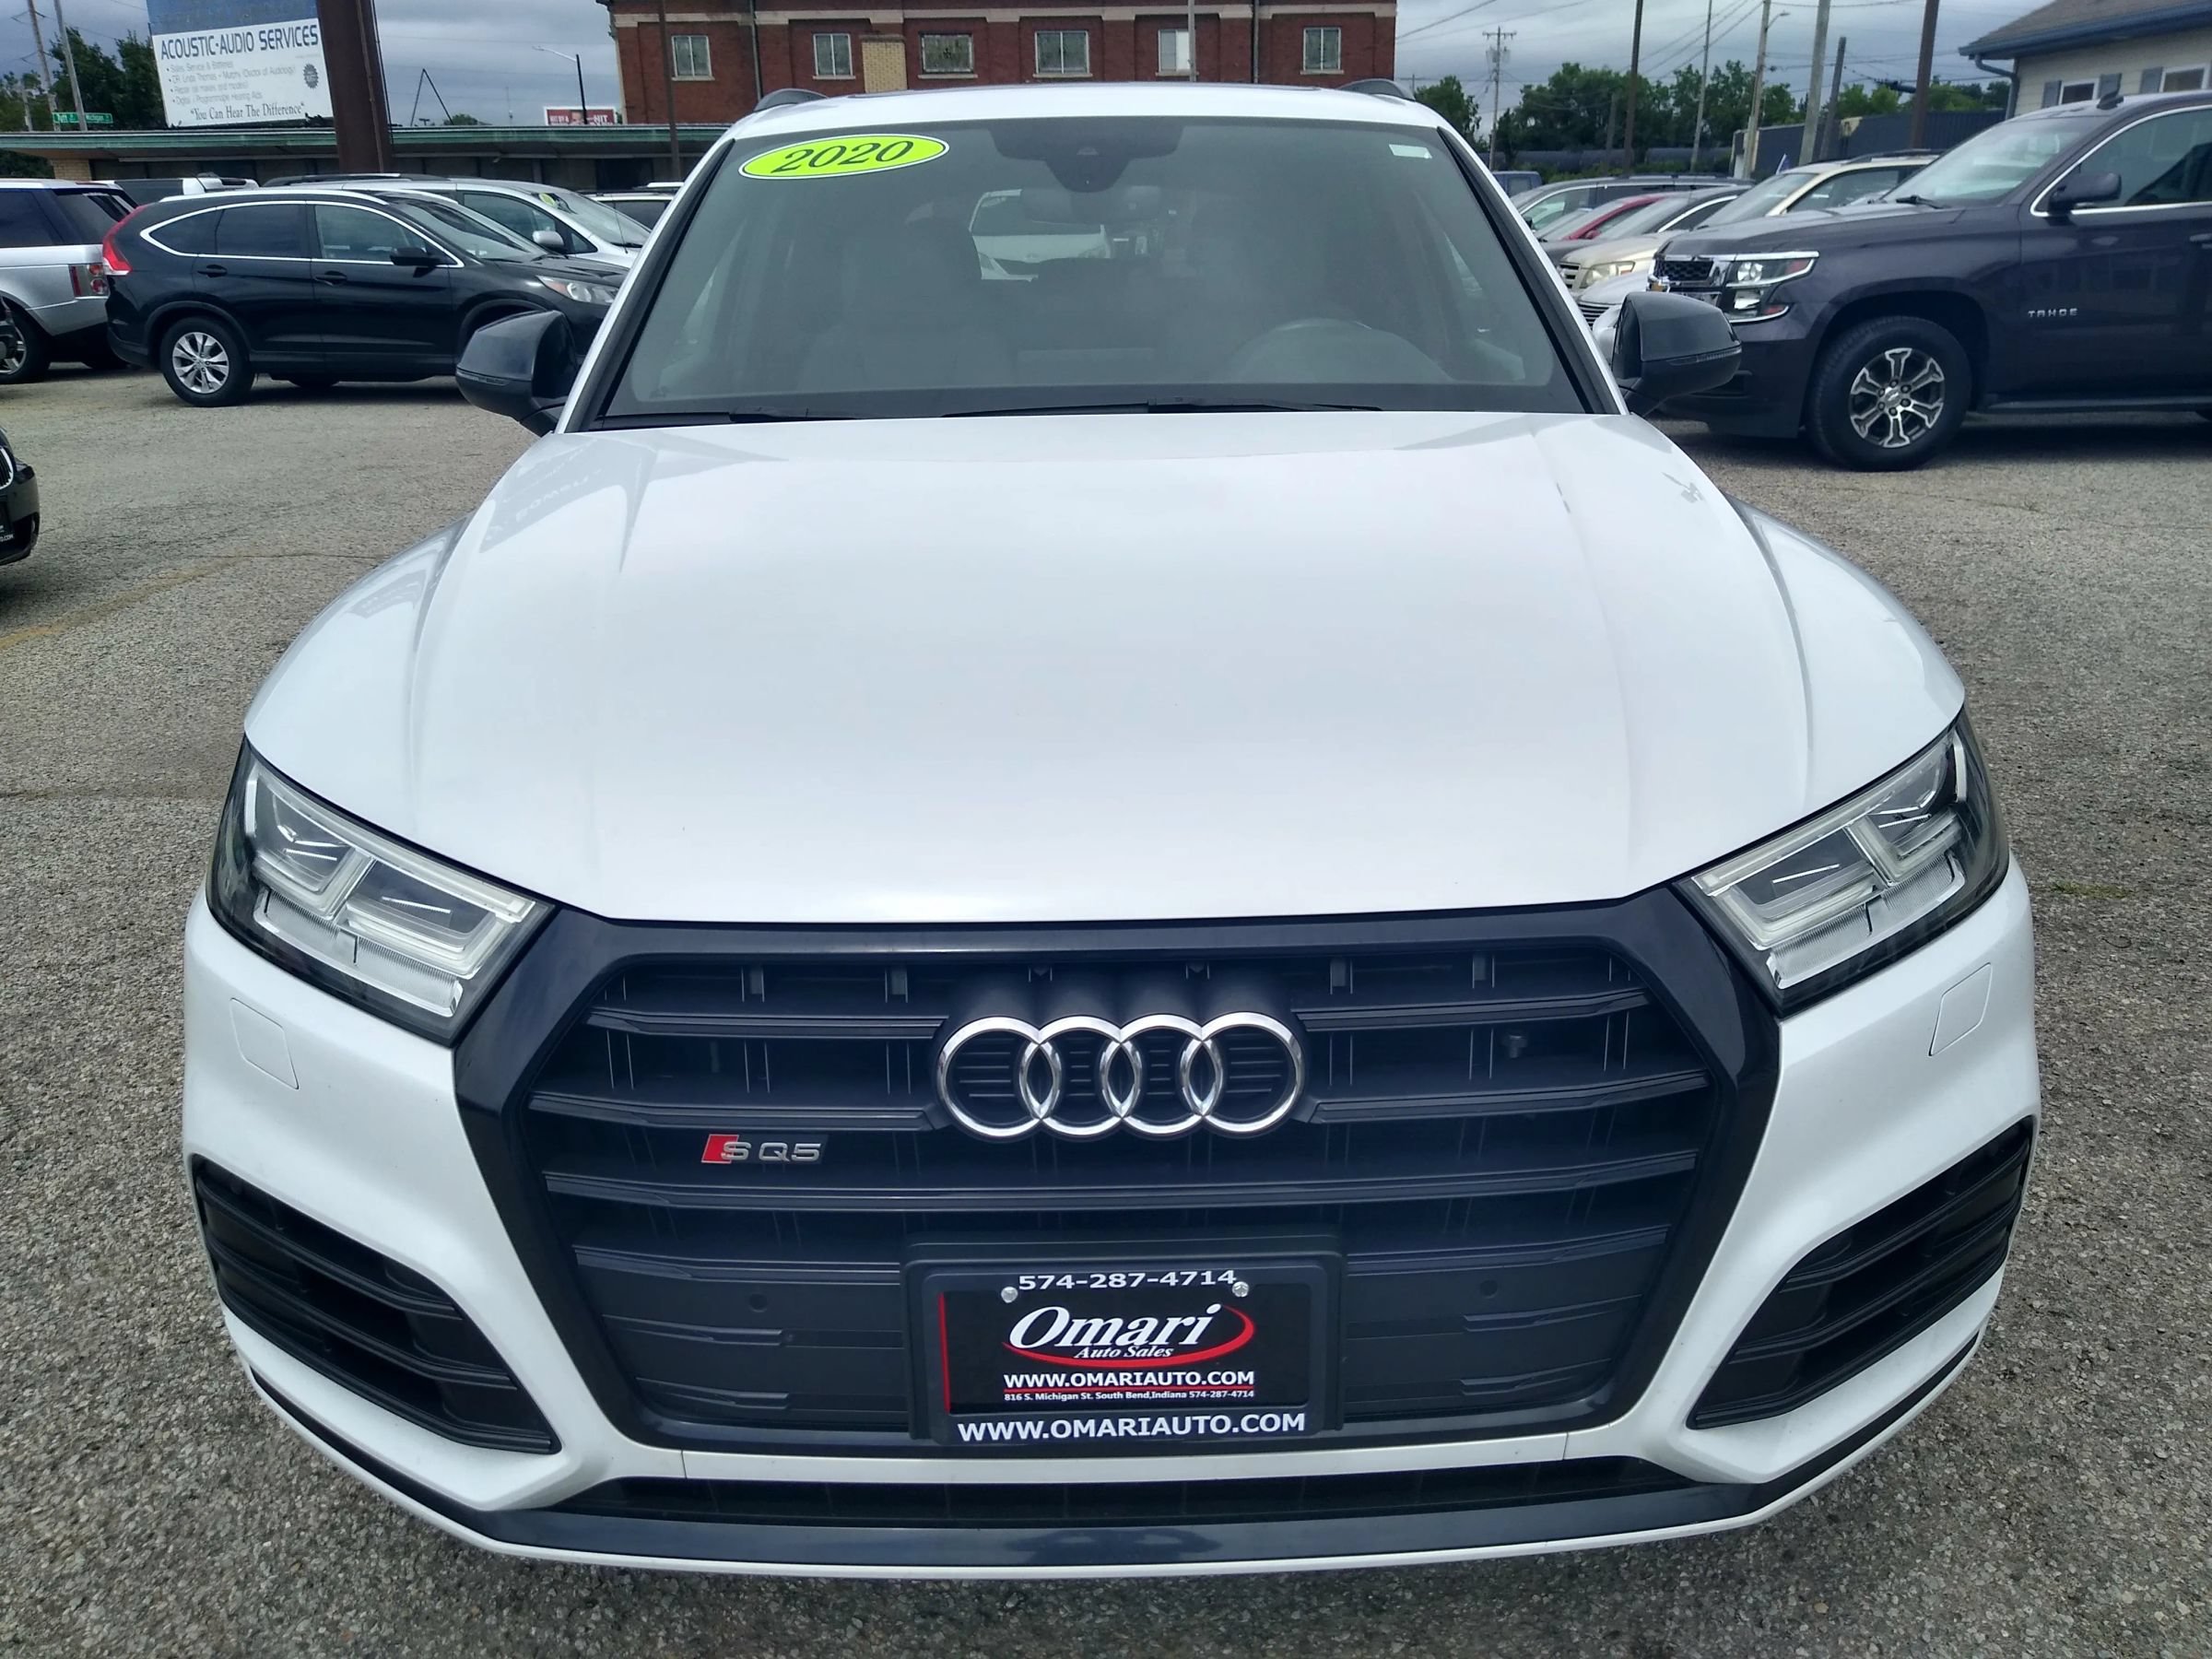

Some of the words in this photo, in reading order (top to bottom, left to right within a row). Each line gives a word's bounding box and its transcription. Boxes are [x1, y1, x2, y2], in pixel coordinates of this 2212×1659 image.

[259, 24, 319, 51] SERVICES
[208, 108, 224, 120] Can
[226, 106, 243, 118] Hear
[245, 104, 260, 117] The
[771, 140, 914, 174] 2020
[2028, 308, 2078, 318] TAHOE
[1018, 1270, 1237, 1290] 574-287-4714
[1008, 1303, 1221, 1348] Omari
[1074, 1346, 1122, 1359] Auto
[1124, 1345, 1174, 1359] Sales
[1003, 1371, 1254, 1389] WWW.OMARIAUTO.COM
[1035, 1392, 1078, 1402] Michigan
[1095, 1391, 1124, 1399] South
[1189, 1390, 1254, 1398] 574-287-4714
[958, 1413, 1306, 1441] WWW.OMARIAUTO.COM
